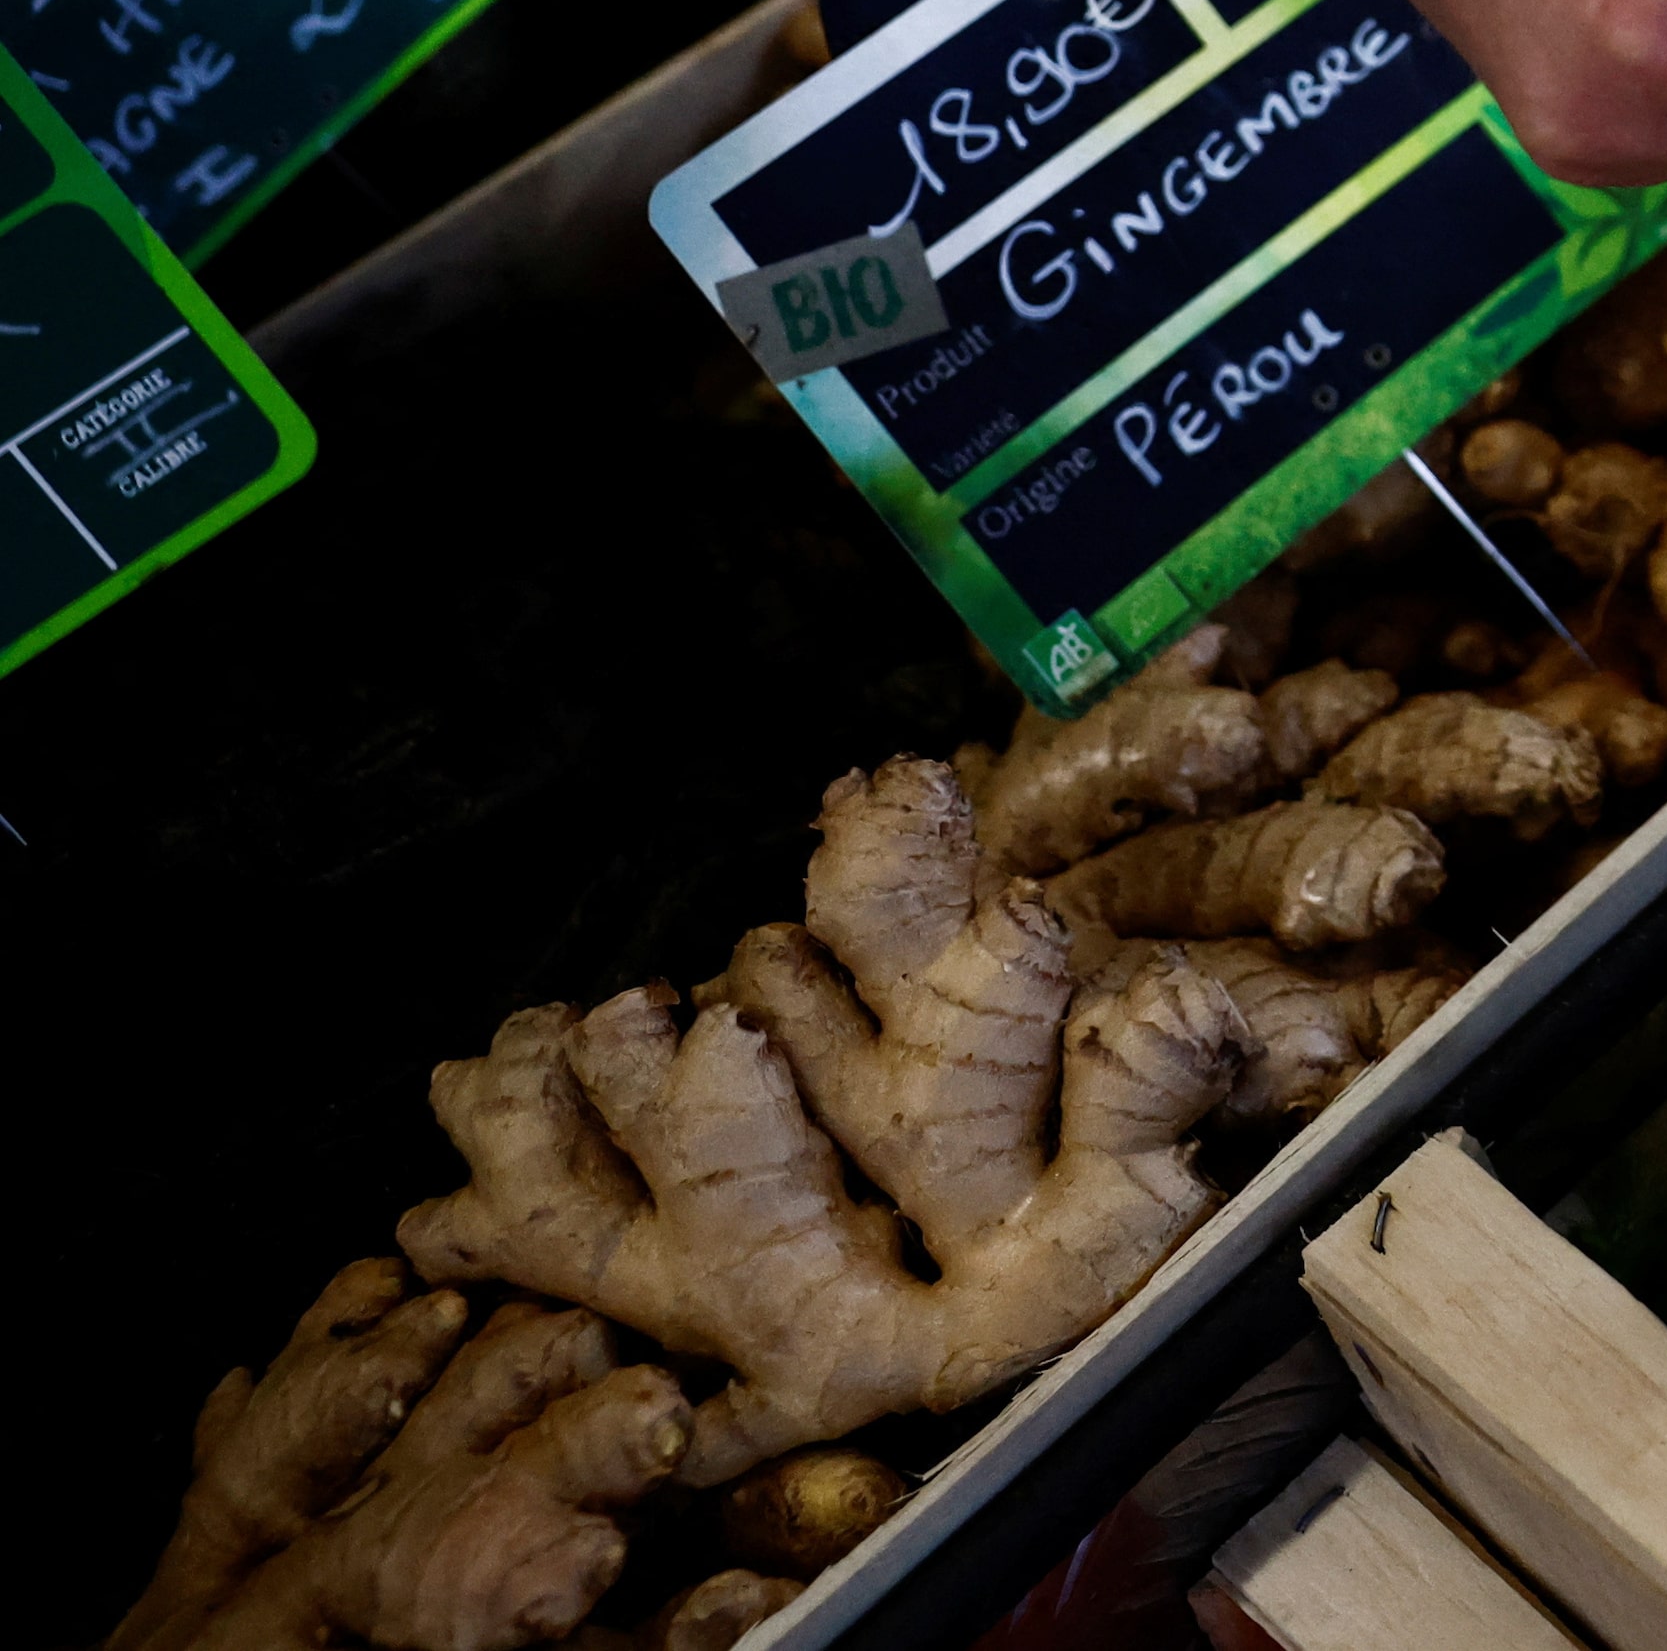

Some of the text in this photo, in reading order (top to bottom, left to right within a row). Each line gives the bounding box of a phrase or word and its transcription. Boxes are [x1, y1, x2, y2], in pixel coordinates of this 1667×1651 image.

[771, 254, 903, 353] BIO
[876, 325, 993, 419] Produit
[118, 429, 209, 498] CALIBRE
[978, 447, 1097, 539] Origine
